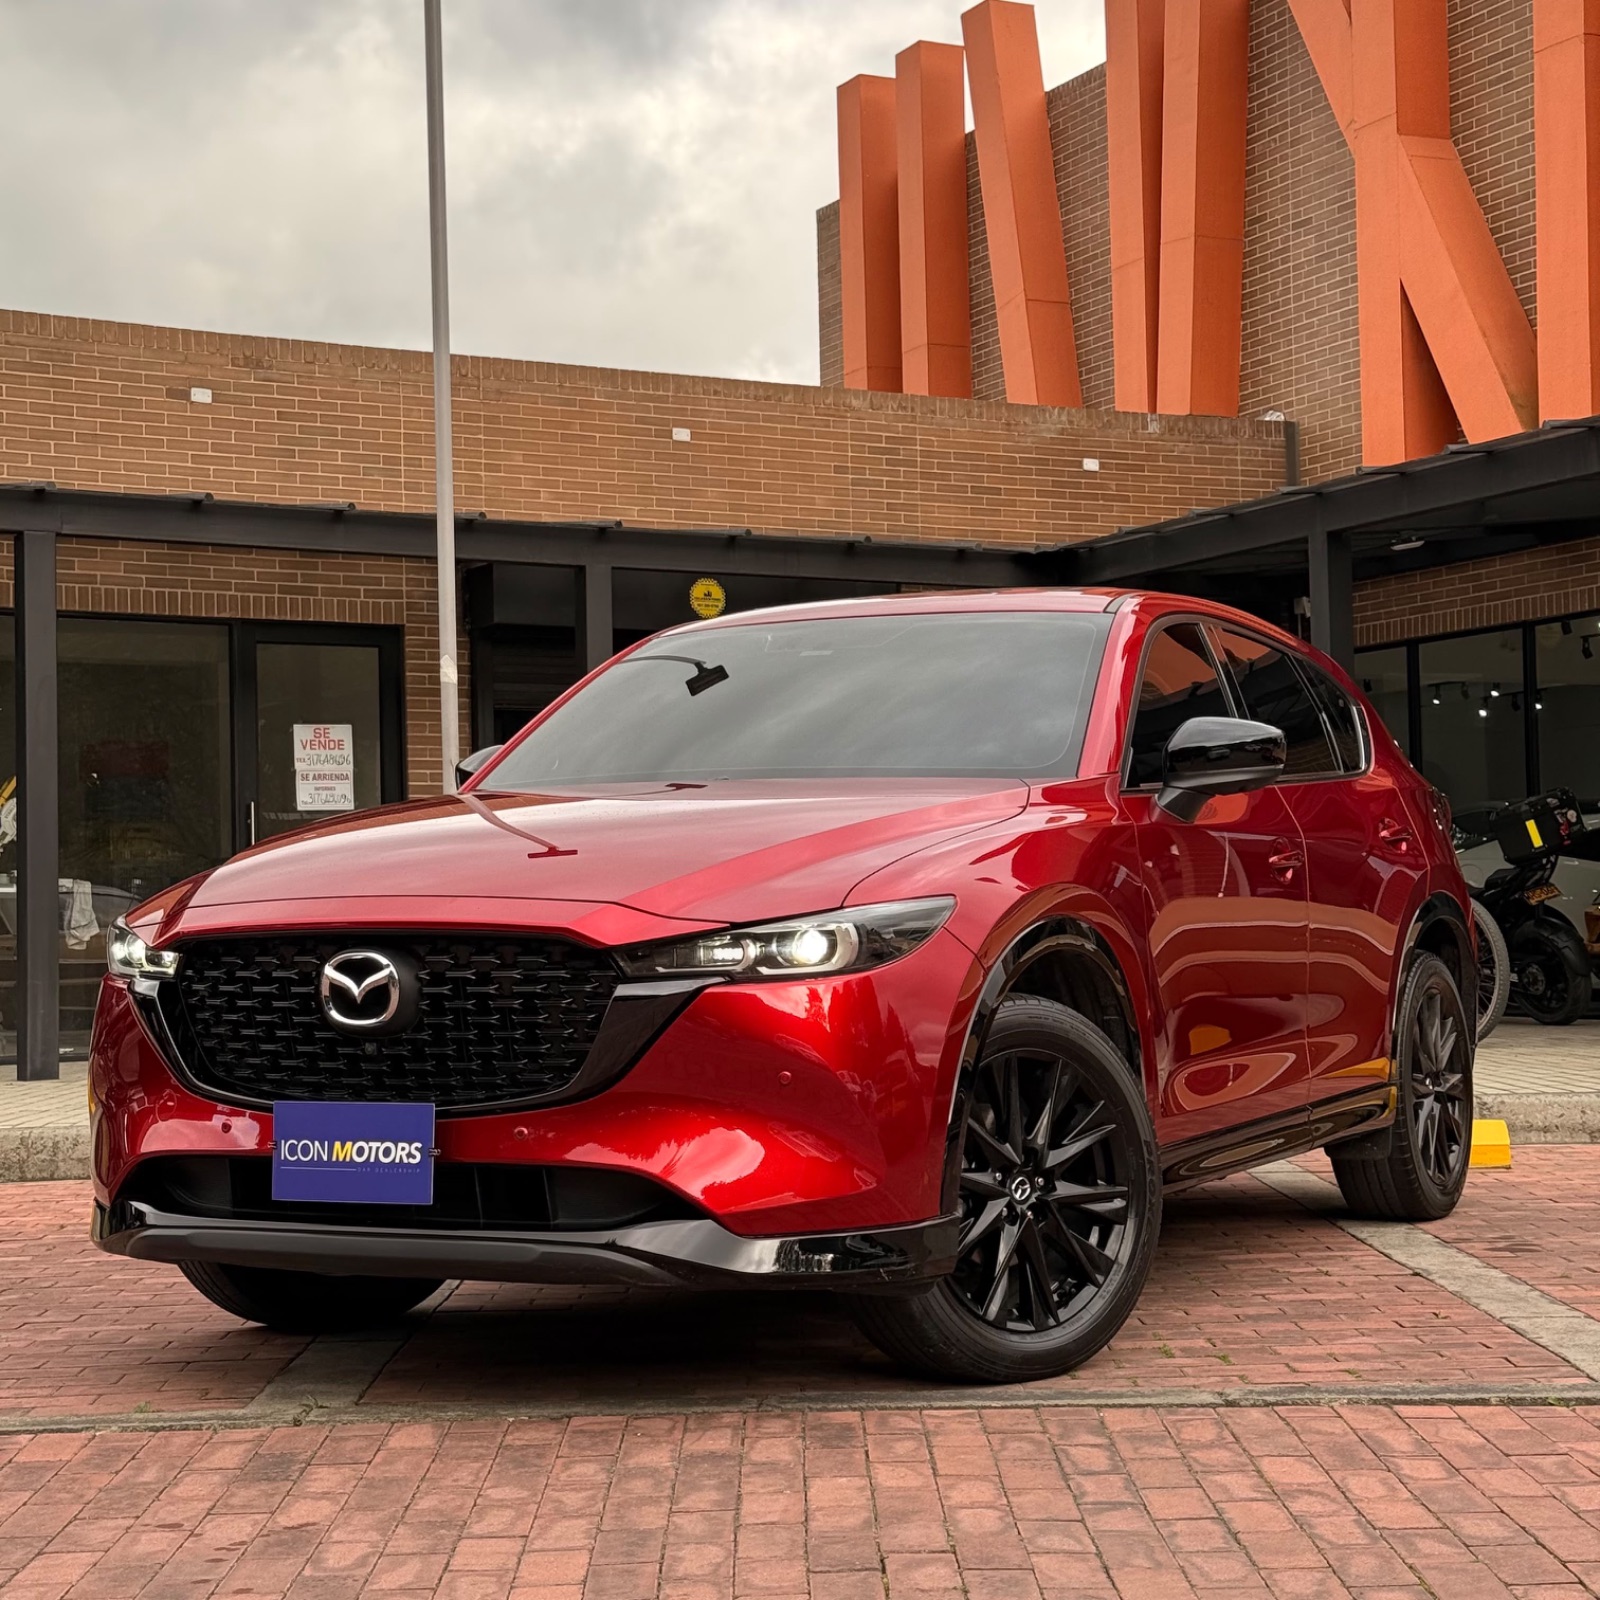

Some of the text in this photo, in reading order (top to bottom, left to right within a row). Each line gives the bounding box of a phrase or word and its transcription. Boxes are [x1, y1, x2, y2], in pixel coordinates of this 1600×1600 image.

[313, 727, 331, 739] SE
[300, 739, 345, 750] VENDE
[300, 773, 350, 781] SE ARRIENDA
[280, 1139, 423, 1164] ICON MOTORS
